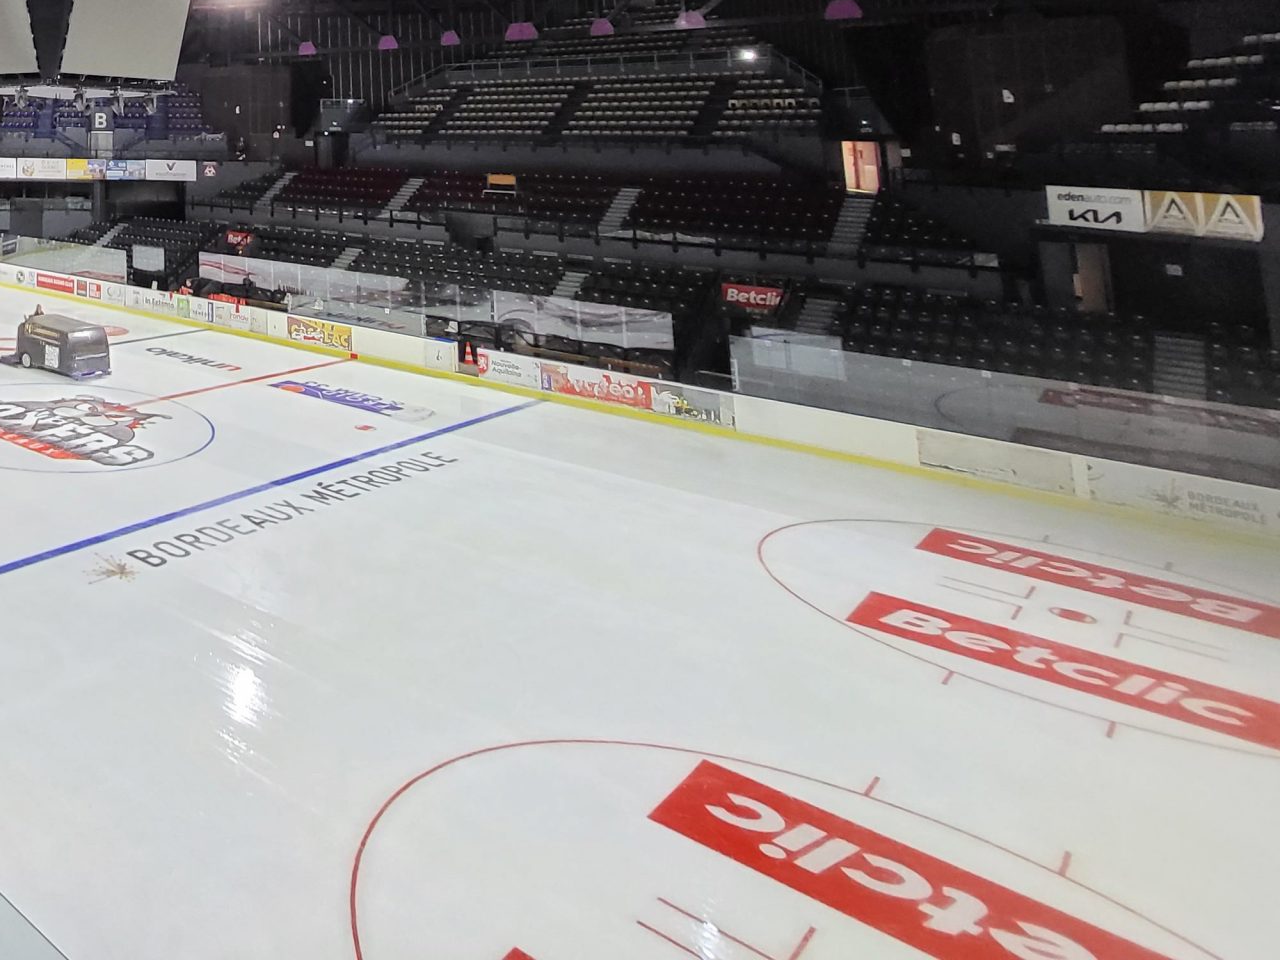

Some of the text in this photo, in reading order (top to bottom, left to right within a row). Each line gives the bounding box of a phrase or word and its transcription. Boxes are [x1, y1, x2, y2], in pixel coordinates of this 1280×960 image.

[94, 112, 108, 129] B
[1057, 191, 1132, 205] edenauto.com
[127, 451, 459, 568] BORDEAUX MÉTROPOLE
[1186, 490, 1260, 512] BORDEAUX
[946, 538, 1265, 624] Betclic
[877, 608, 1258, 727] Betclic
